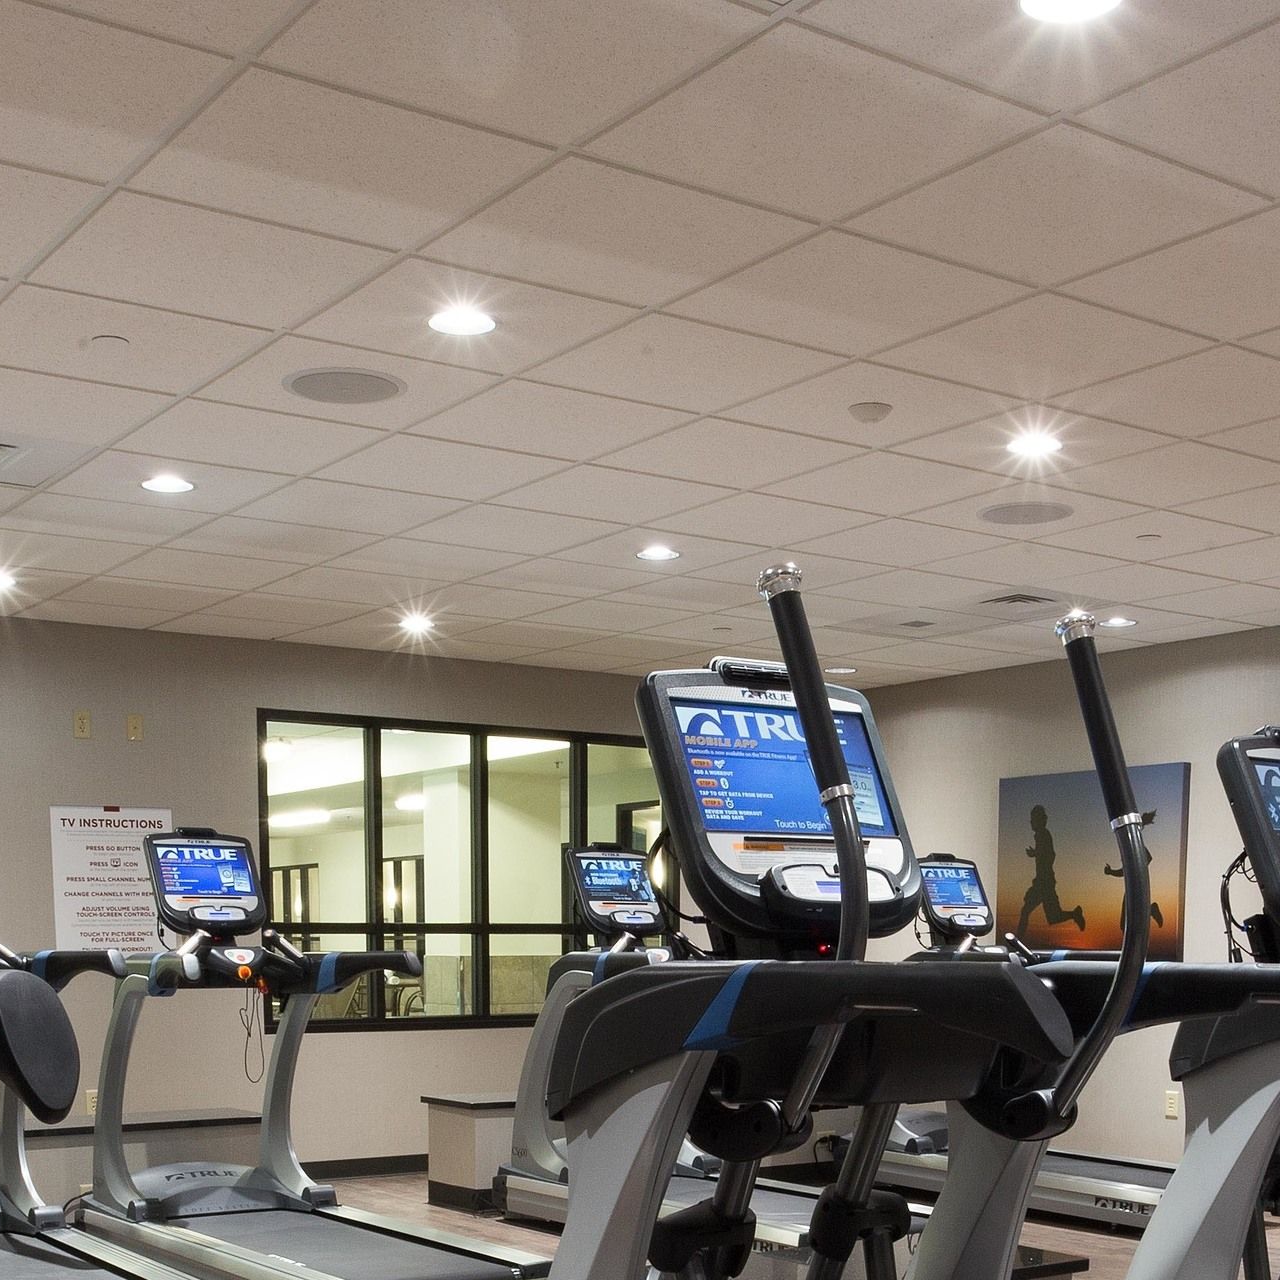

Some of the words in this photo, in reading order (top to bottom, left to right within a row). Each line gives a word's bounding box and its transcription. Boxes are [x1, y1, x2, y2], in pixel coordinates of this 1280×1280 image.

[684, 735, 732, 748] MOBILE
[734, 738, 759, 749] APP
[60, 817, 76, 828] TV
[79, 818, 164, 829] INSTRUCTIONS
[774, 819, 798, 828] Touch
[798, 820, 806, 829] to
[806, 820, 827, 831] Begin
[178, 848, 238, 861] TRUE
[597, 859, 643, 871] TRUE
[934, 868, 971, 879] TRUE
[184, 1170, 241, 1179] TRUE
[1110, 1199, 1150, 1215] TRUE
